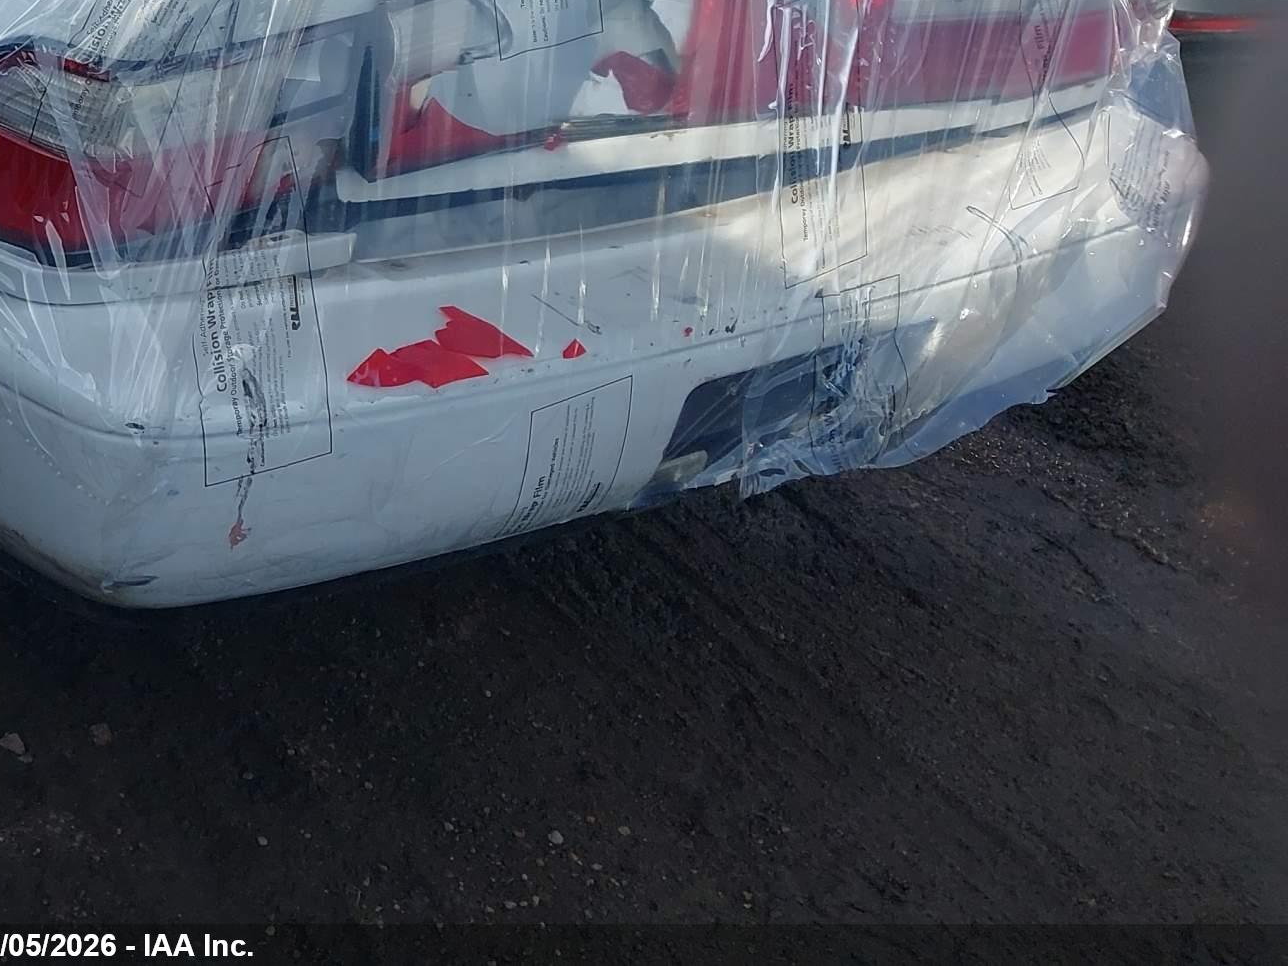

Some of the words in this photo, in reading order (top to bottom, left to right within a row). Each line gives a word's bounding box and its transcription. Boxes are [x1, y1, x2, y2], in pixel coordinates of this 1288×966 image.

[788, 113, 796, 149] Wrap
[206, 291, 217, 330] Wrap
[216, 290, 228, 330] Protection
[211, 331, 228, 392] Collision
[223, 331, 234, 363] Storage
[228, 364, 237, 396] Outdoor
[533, 475, 546, 499] Film
